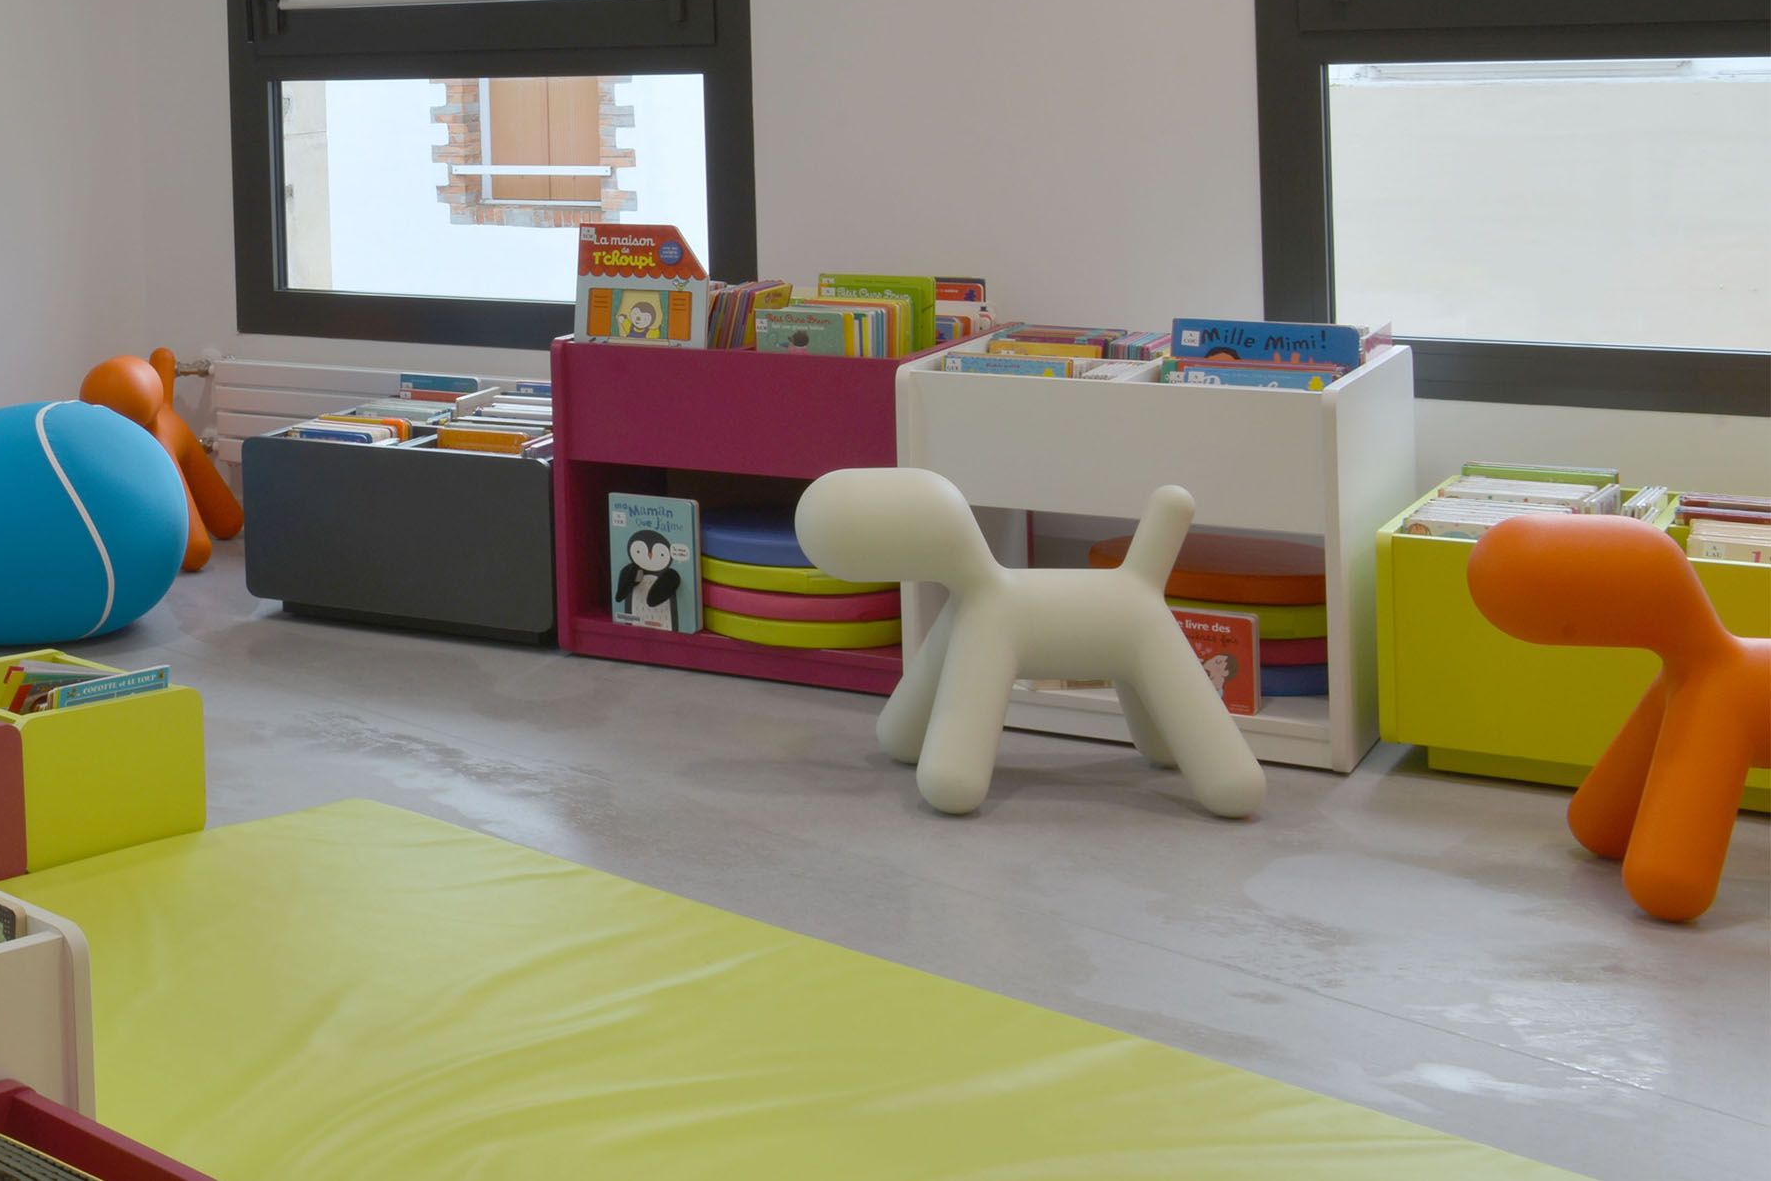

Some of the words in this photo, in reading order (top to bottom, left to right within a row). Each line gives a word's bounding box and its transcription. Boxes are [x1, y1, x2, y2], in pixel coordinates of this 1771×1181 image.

[593, 235, 609, 245] La
[610, 235, 655, 247] maison
[592, 249, 656, 269] T'choupi
[1200, 327, 1256, 348] Mille
[628, 505, 673, 518] Maman
[1184, 619, 1210, 631] livre
[1212, 623, 1232, 633] des
[83, 682, 116, 694] COCOTTE
